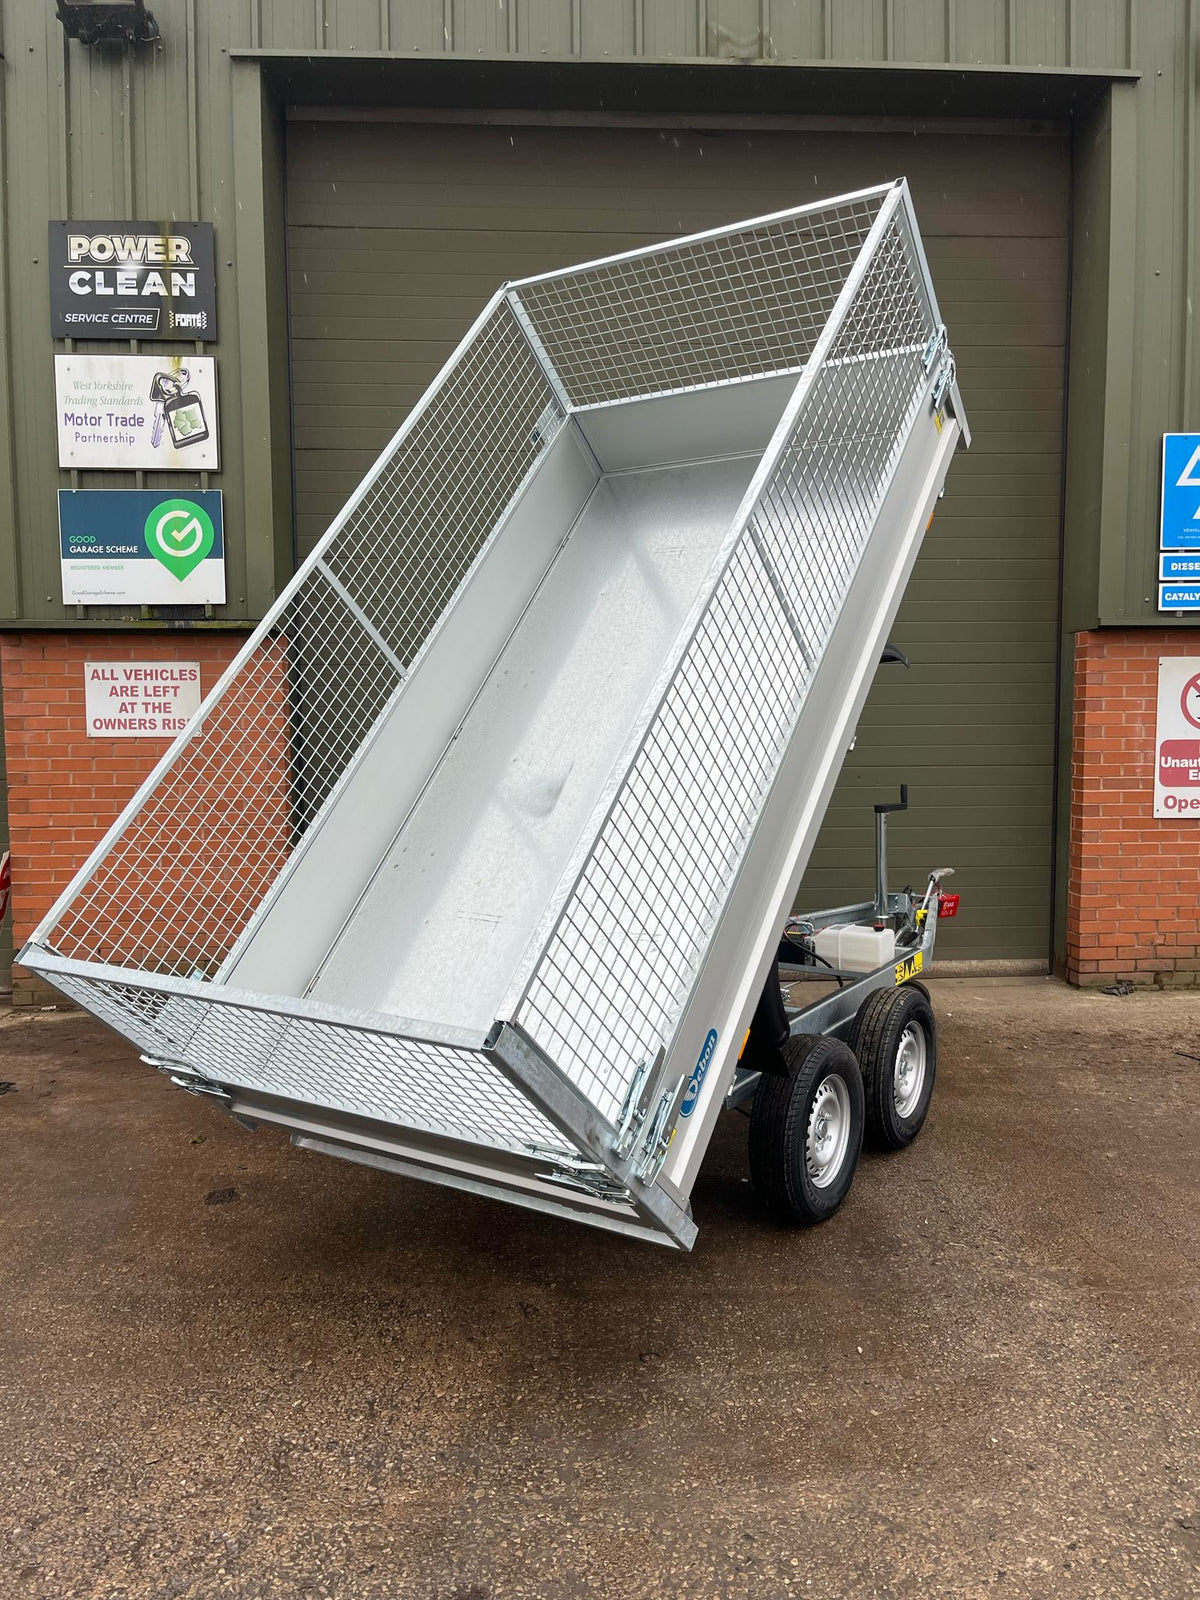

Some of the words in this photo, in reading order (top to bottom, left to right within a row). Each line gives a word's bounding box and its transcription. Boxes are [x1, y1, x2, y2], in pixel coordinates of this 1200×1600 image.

[68, 235, 193, 263] POWER
[68, 271, 196, 296] CLEAN
[64, 313, 109, 323] SERVICE
[111, 314, 154, 324] CENTRE
[73, 381, 91, 390] West
[93, 381, 134, 391] Yorkshire
[64, 395, 98, 408] Trading
[99, 396, 144, 406] Standards
[64, 412, 103, 426] Motor
[106, 413, 145, 427] Trade
[75, 431, 135, 446] Partnership
[69, 535, 97, 543] GOOD
[69, 545, 104, 554] GARAGE
[105, 545, 139, 554] SCHEME
[90, 669, 119, 681] ALL
[123, 669, 198, 681] VEHICLES
[108, 685, 139, 698] ARE
[143, 686, 180, 698] LEFT
[118, 702, 137, 714] AT
[141, 702, 172, 714] THE
[92, 718, 157, 730] OWNERS
[161, 718, 190, 730] RIS
